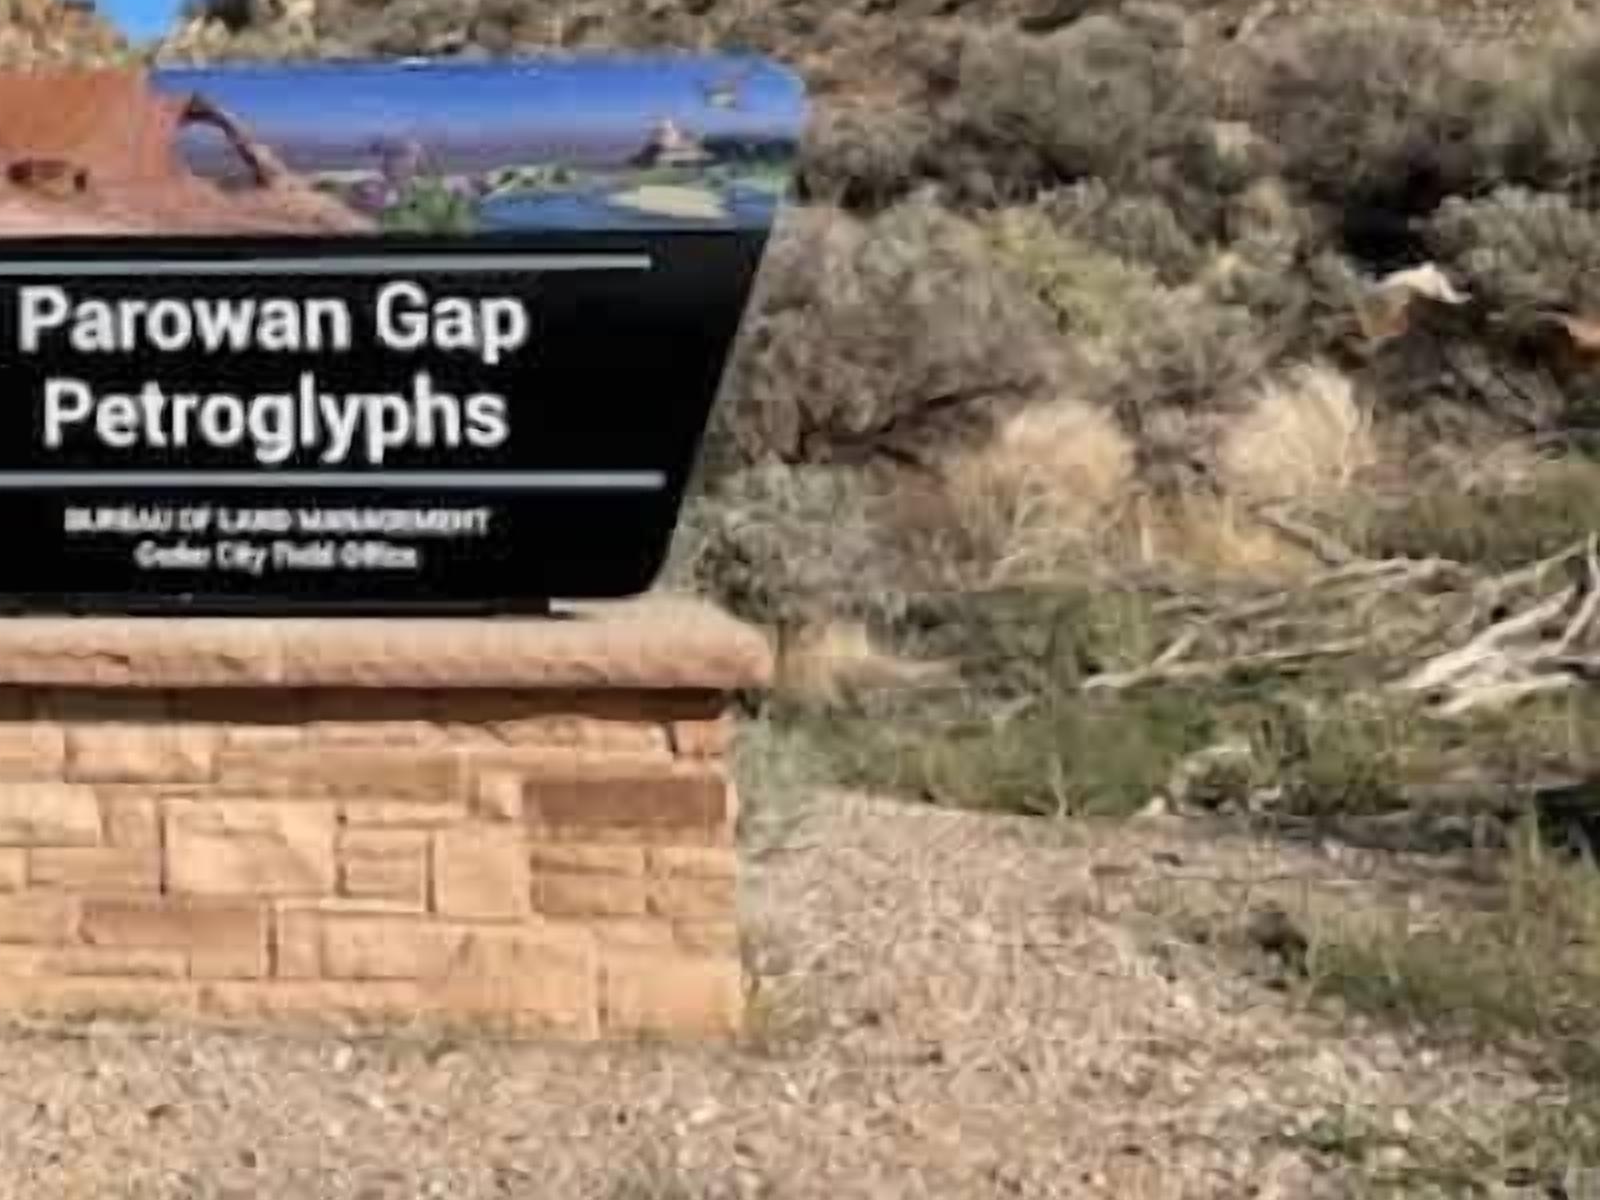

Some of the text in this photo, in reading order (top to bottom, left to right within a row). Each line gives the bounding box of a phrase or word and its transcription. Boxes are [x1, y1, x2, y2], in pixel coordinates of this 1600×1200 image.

[18, 281, 529, 365] Parowan Gap
[43, 372, 509, 465] Petroglyphs
